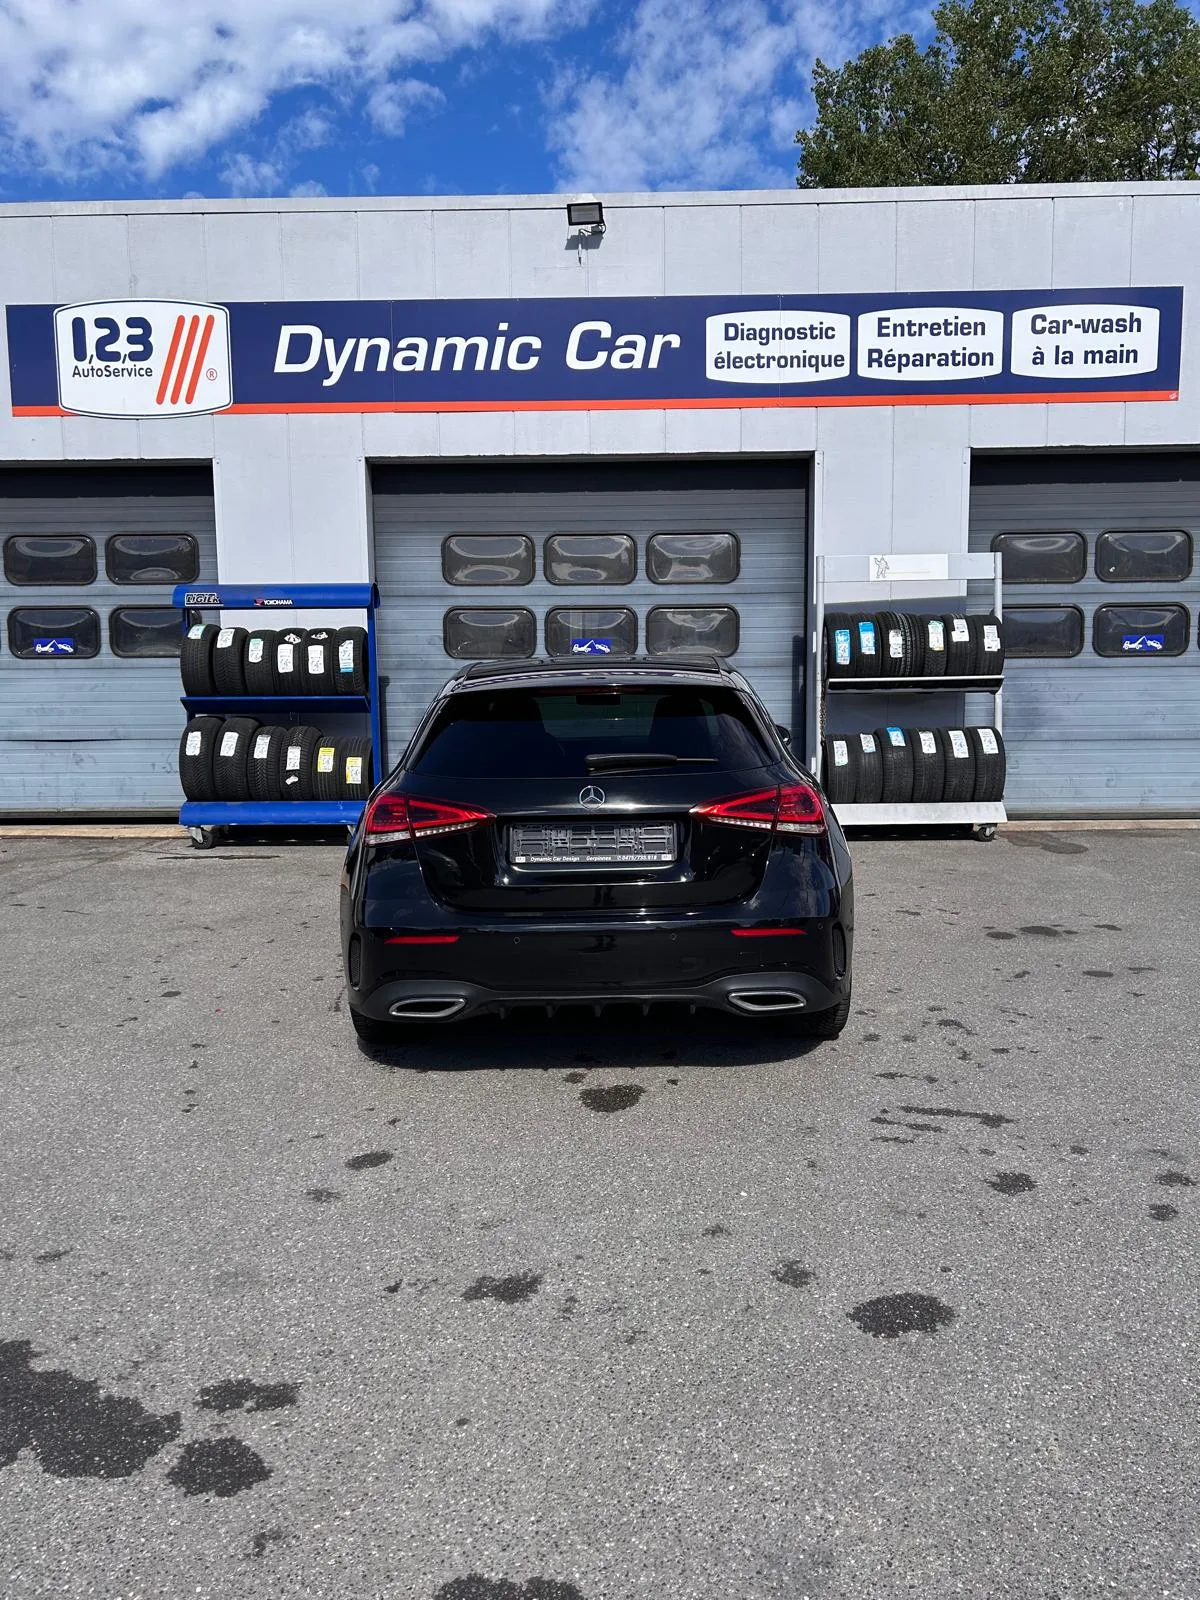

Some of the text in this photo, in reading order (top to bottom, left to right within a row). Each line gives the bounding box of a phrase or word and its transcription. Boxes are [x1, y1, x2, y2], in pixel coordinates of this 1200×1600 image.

[724, 321, 836, 346] Diagnostic
[877, 315, 986, 338] Entretien
[1030, 312, 1142, 335] Car-wash
[273, 320, 681, 387] Dynamic Car
[714, 350, 845, 373] électronique
[867, 346, 994, 373] Réparation
[1031, 343, 1138, 365] à la main
[72, 365, 153, 378] AutoService
